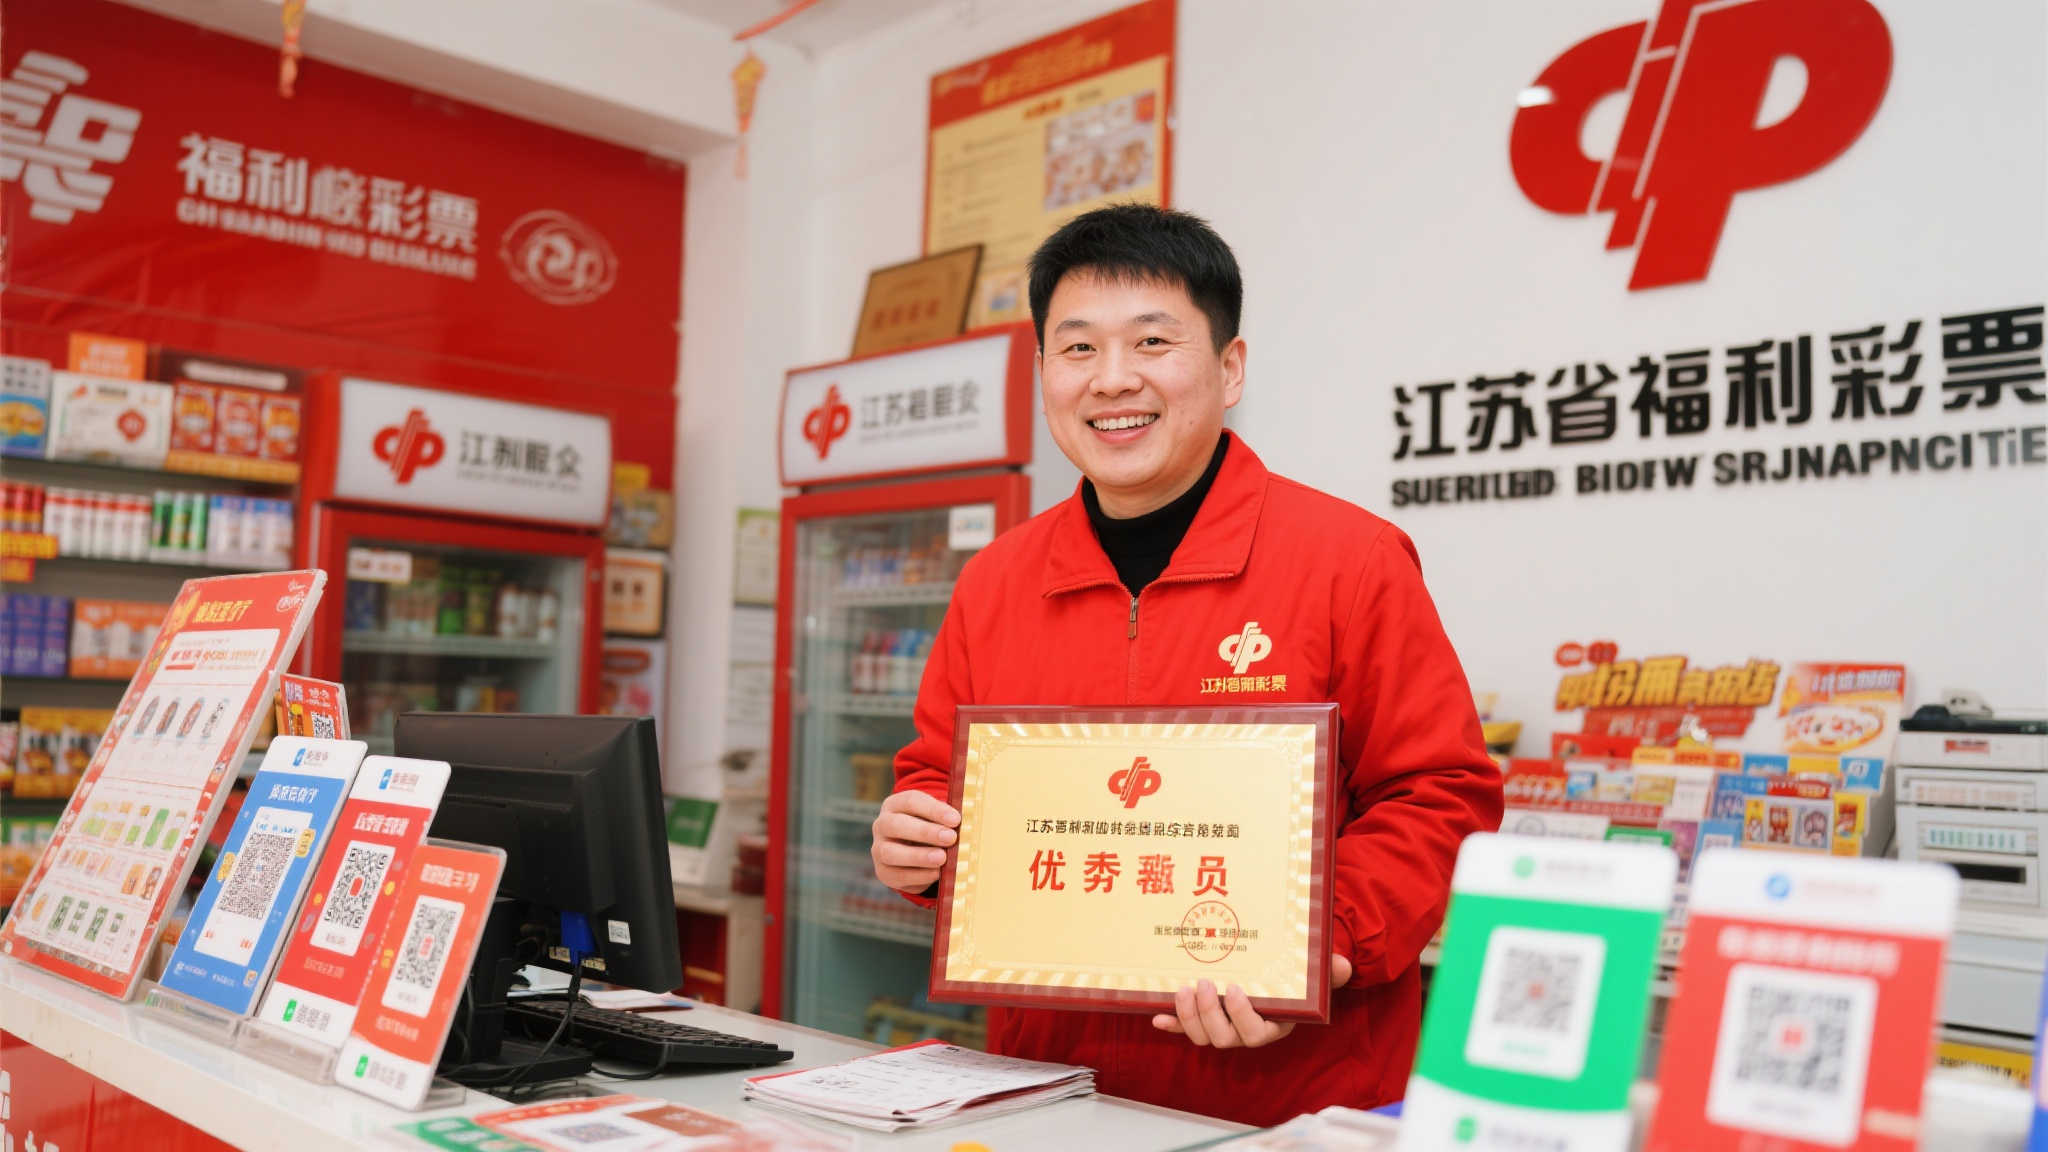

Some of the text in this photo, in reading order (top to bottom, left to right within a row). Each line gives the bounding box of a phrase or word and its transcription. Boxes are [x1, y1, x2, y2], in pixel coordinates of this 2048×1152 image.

[1393, 305, 2046, 461] 江苏省福利彩票
